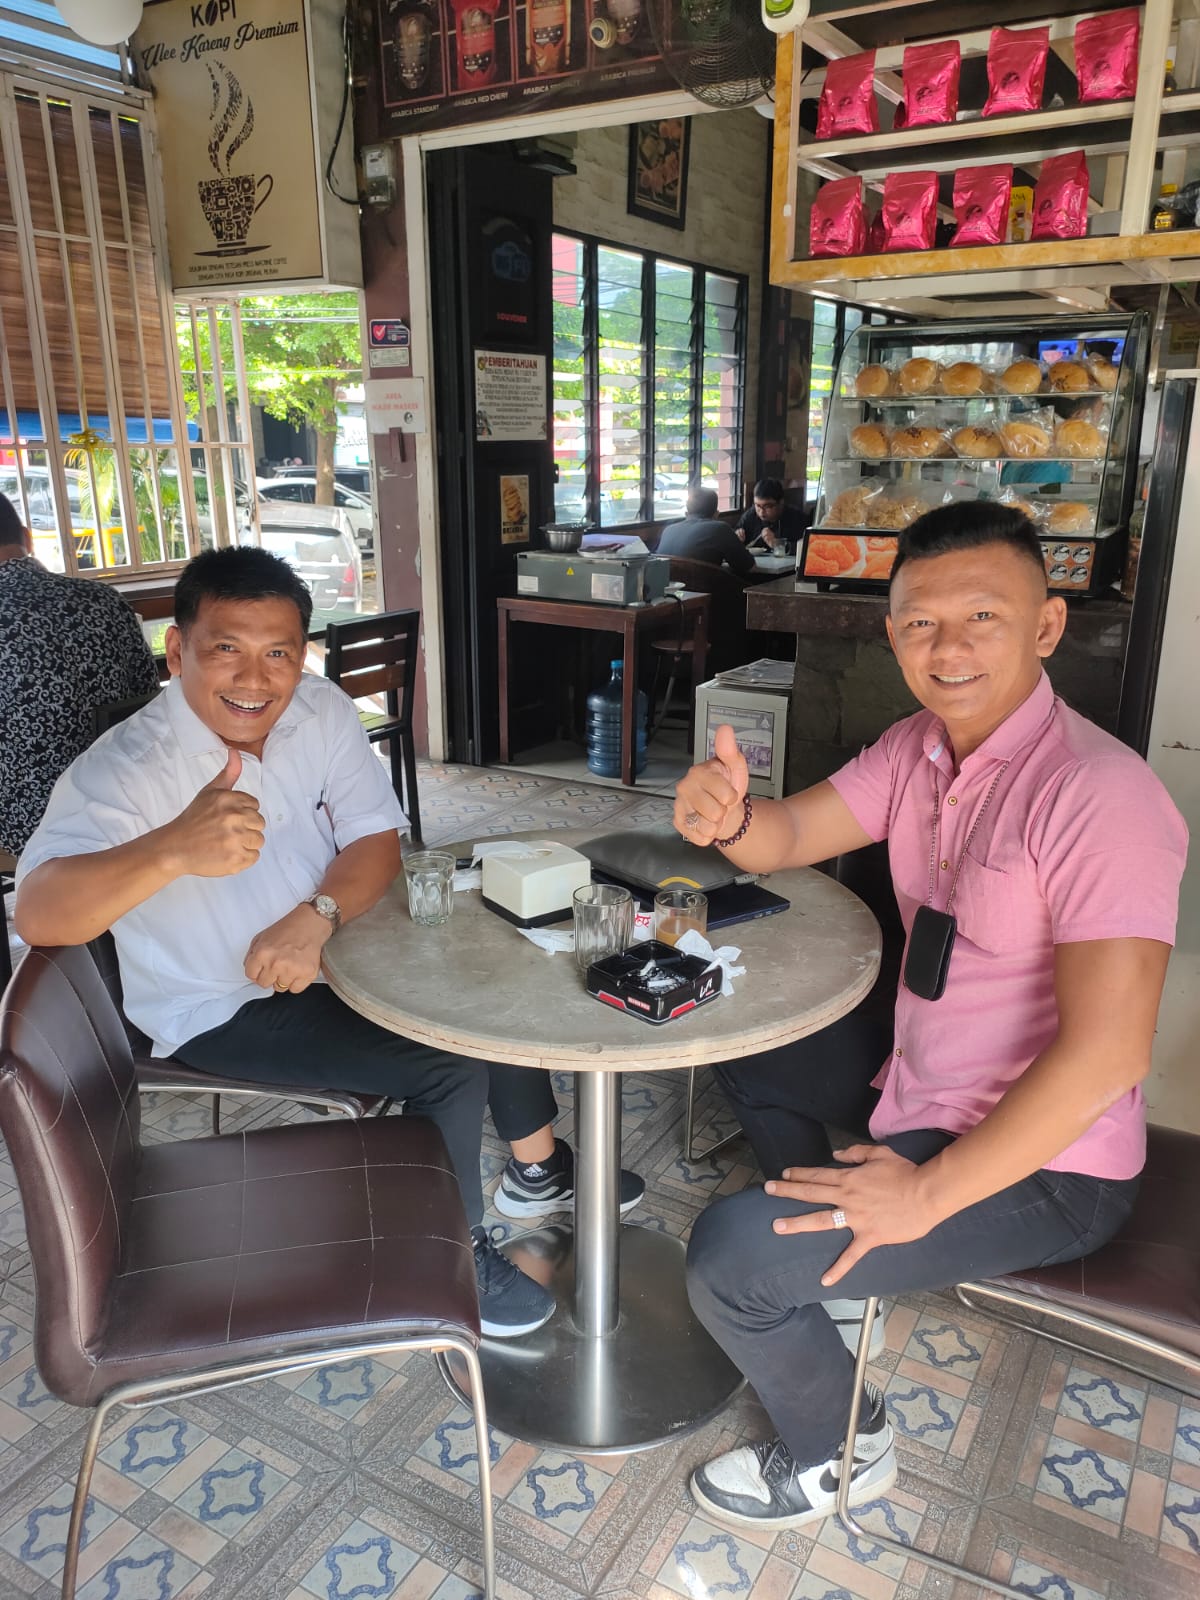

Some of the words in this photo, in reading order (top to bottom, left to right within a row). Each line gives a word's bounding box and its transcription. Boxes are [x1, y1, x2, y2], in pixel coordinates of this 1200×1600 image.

[191, 0, 236, 28] KOPI
[142, 42, 177, 71] Ulee
[180, 33, 231, 63] Kareng
[233, 21, 299, 50] Premium
[523, 84, 549, 96] ARABICA
[484, 356, 538, 369] PEMBERITAHUAN
